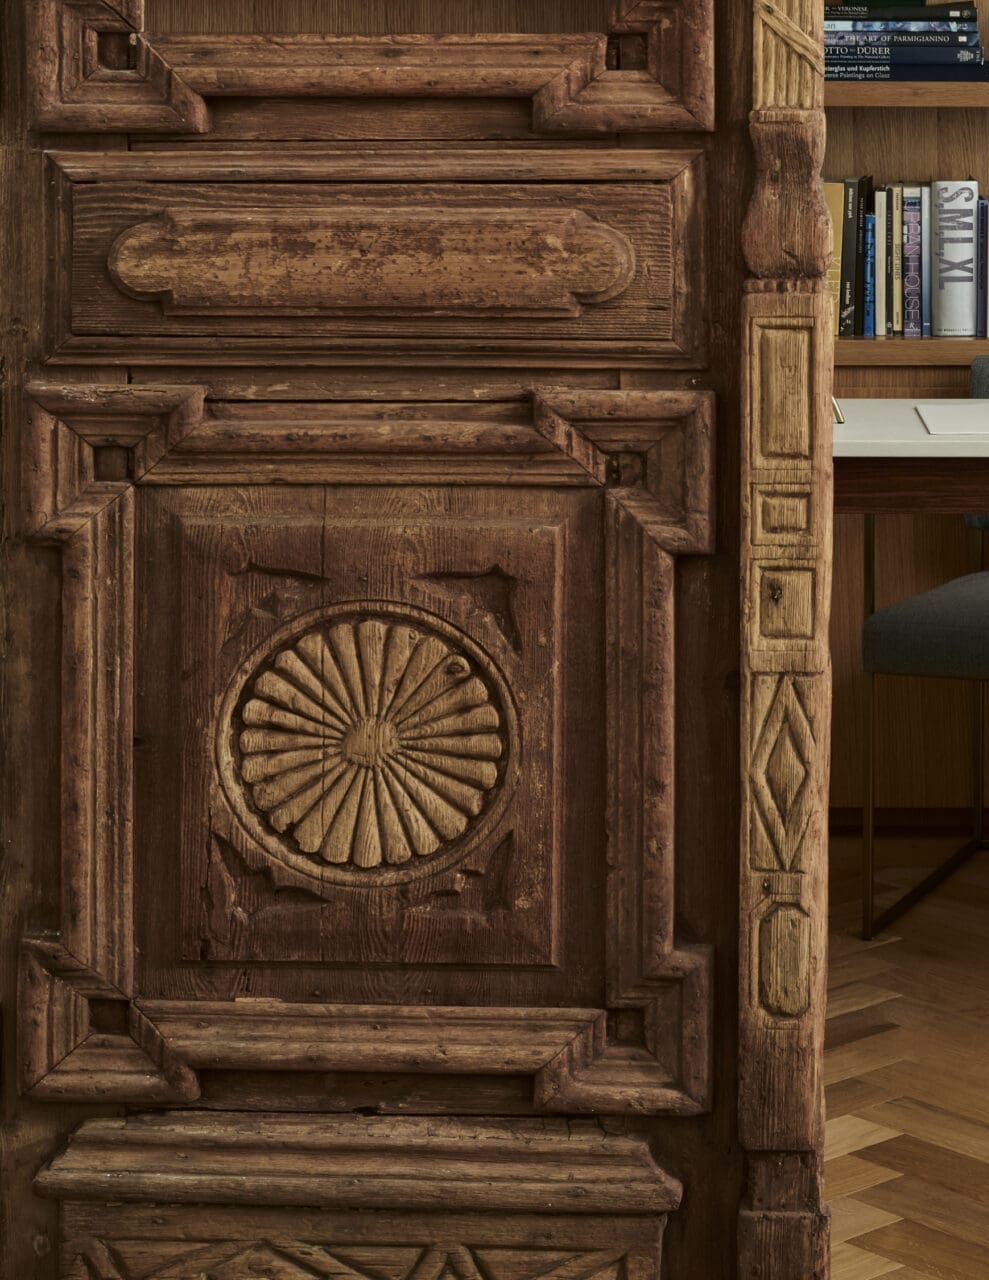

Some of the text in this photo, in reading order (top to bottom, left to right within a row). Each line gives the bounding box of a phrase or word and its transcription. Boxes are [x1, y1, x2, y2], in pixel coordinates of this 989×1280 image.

[844, 35, 860, 43] THE
[863, 35, 878, 43] ART
[880, 35, 892, 43] OF
[893, 35, 950, 43] PARMIGIANINO
[856, 45, 891, 55] DÜRER
[859, 65, 891, 73] Kupferstich
[934, 186, 975, 290] S,M,L,XL
[904, 198, 921, 321] URBAN HOUSE
